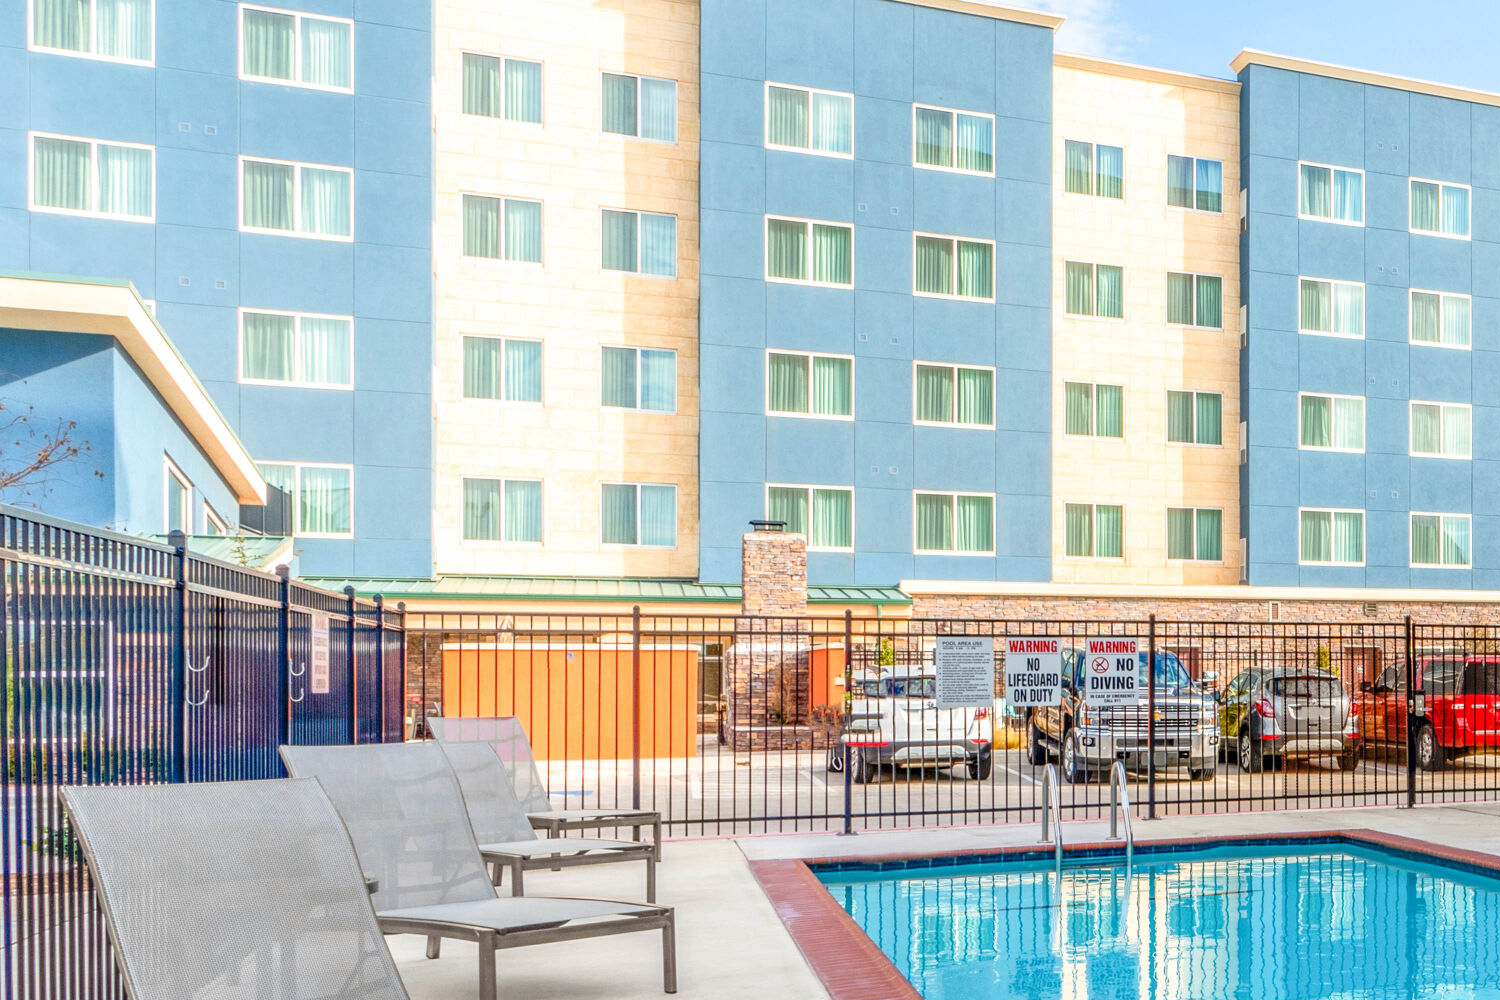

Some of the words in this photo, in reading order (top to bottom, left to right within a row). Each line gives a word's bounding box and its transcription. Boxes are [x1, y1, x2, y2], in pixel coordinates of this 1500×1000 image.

[1009, 640, 1057, 652] WARNING
[1089, 641, 1136, 653] WARNING
[1027, 657, 1040, 671] NO
[1116, 658, 1134, 671] NO
[1008, 673, 1059, 687] LIFEGUARD
[1091, 676, 1134, 690] DIVING
[1014, 689, 1027, 702] ON
[1030, 689, 1053, 702] DUTY
